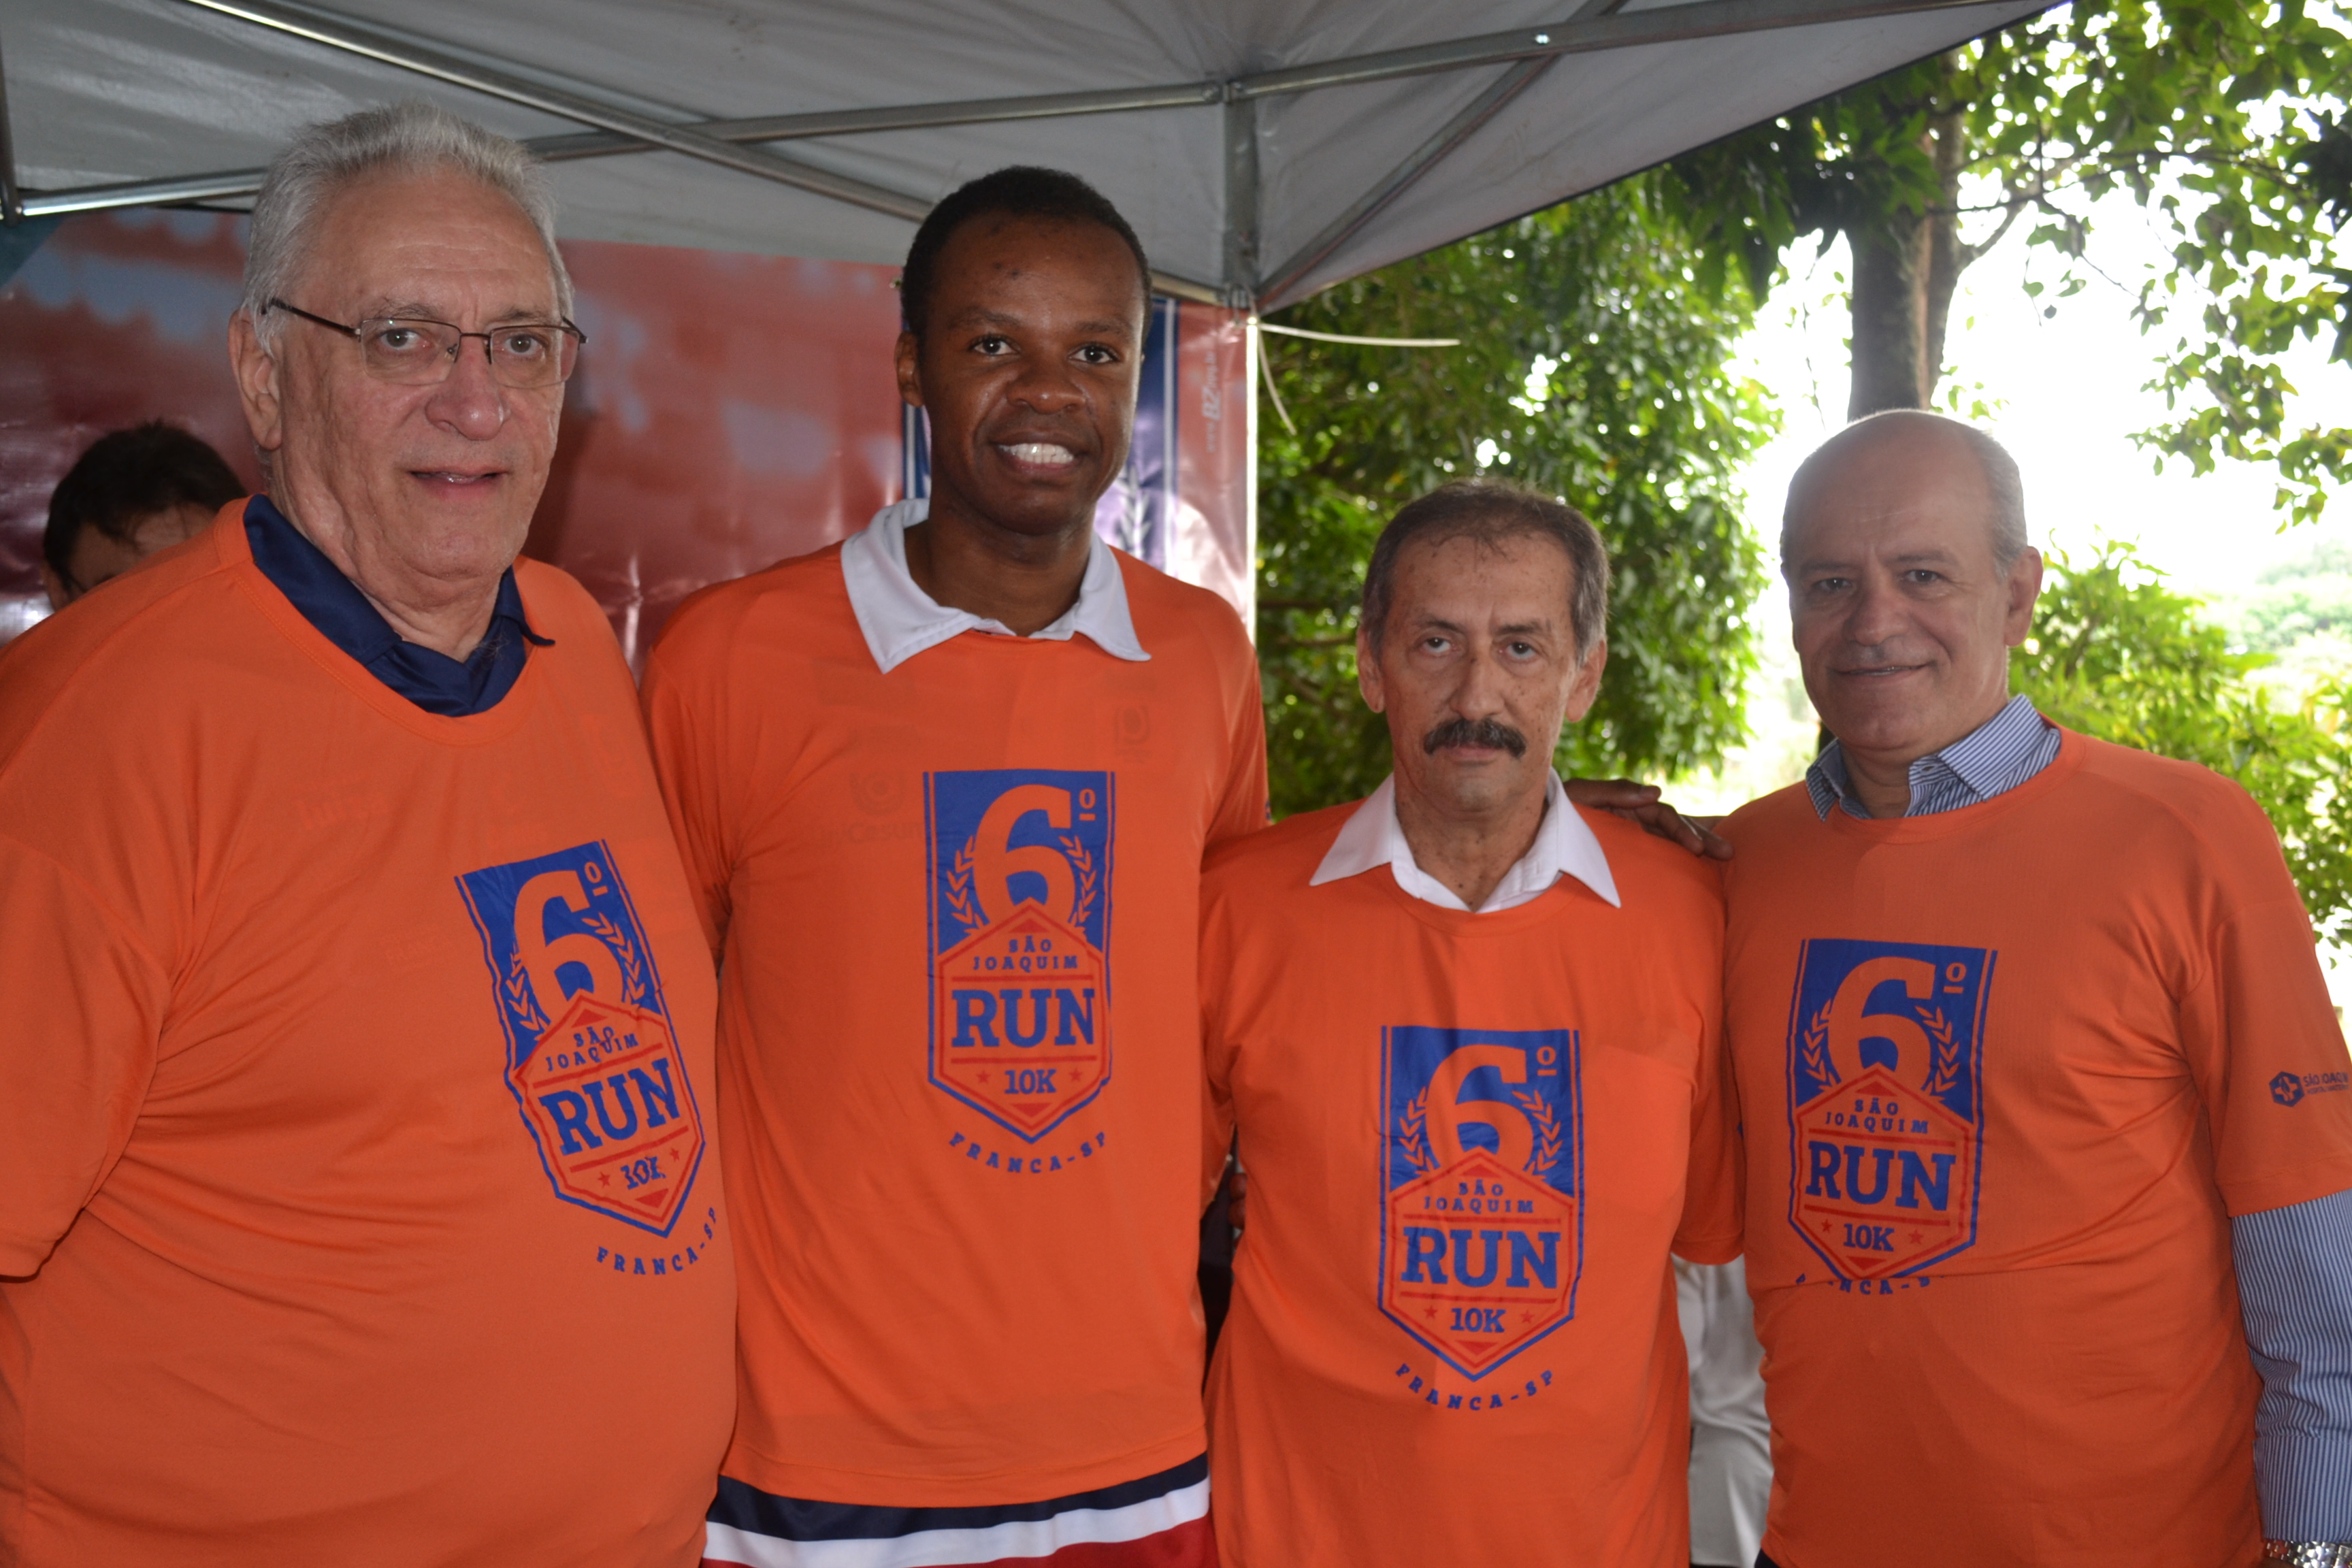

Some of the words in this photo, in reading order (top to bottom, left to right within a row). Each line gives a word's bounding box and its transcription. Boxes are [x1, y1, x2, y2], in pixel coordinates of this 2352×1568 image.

[1009, 936, 1052, 953] SÃO
[973, 955, 1078, 973] JOAQUIM
[951, 987, 1095, 1048] RUN
[573, 1026, 615, 1047] SÃO
[545, 1033, 639, 1072] JOAQUIM
[1003, 1068, 1057, 1094] 10K
[539, 1057, 681, 1156] RUN
[1854, 1097, 1899, 1116] SÃO
[1825, 1112, 1929, 1134] JOAQUIM
[949, 1132, 1105, 1173] FRANCA-SP
[1458, 1179, 1504, 1197] SÃO
[1806, 1141, 1957, 1211] RUN
[1424, 1196, 1535, 1214] JOAQUIM
[596, 1207, 717, 1275] FRANCA-SP
[1842, 1223, 1895, 1252] 10K
[1400, 1226, 1561, 1289] RUN
[1450, 1307, 1507, 1333] 10K
[1395, 1364, 1554, 1411] FRANCA-SP
